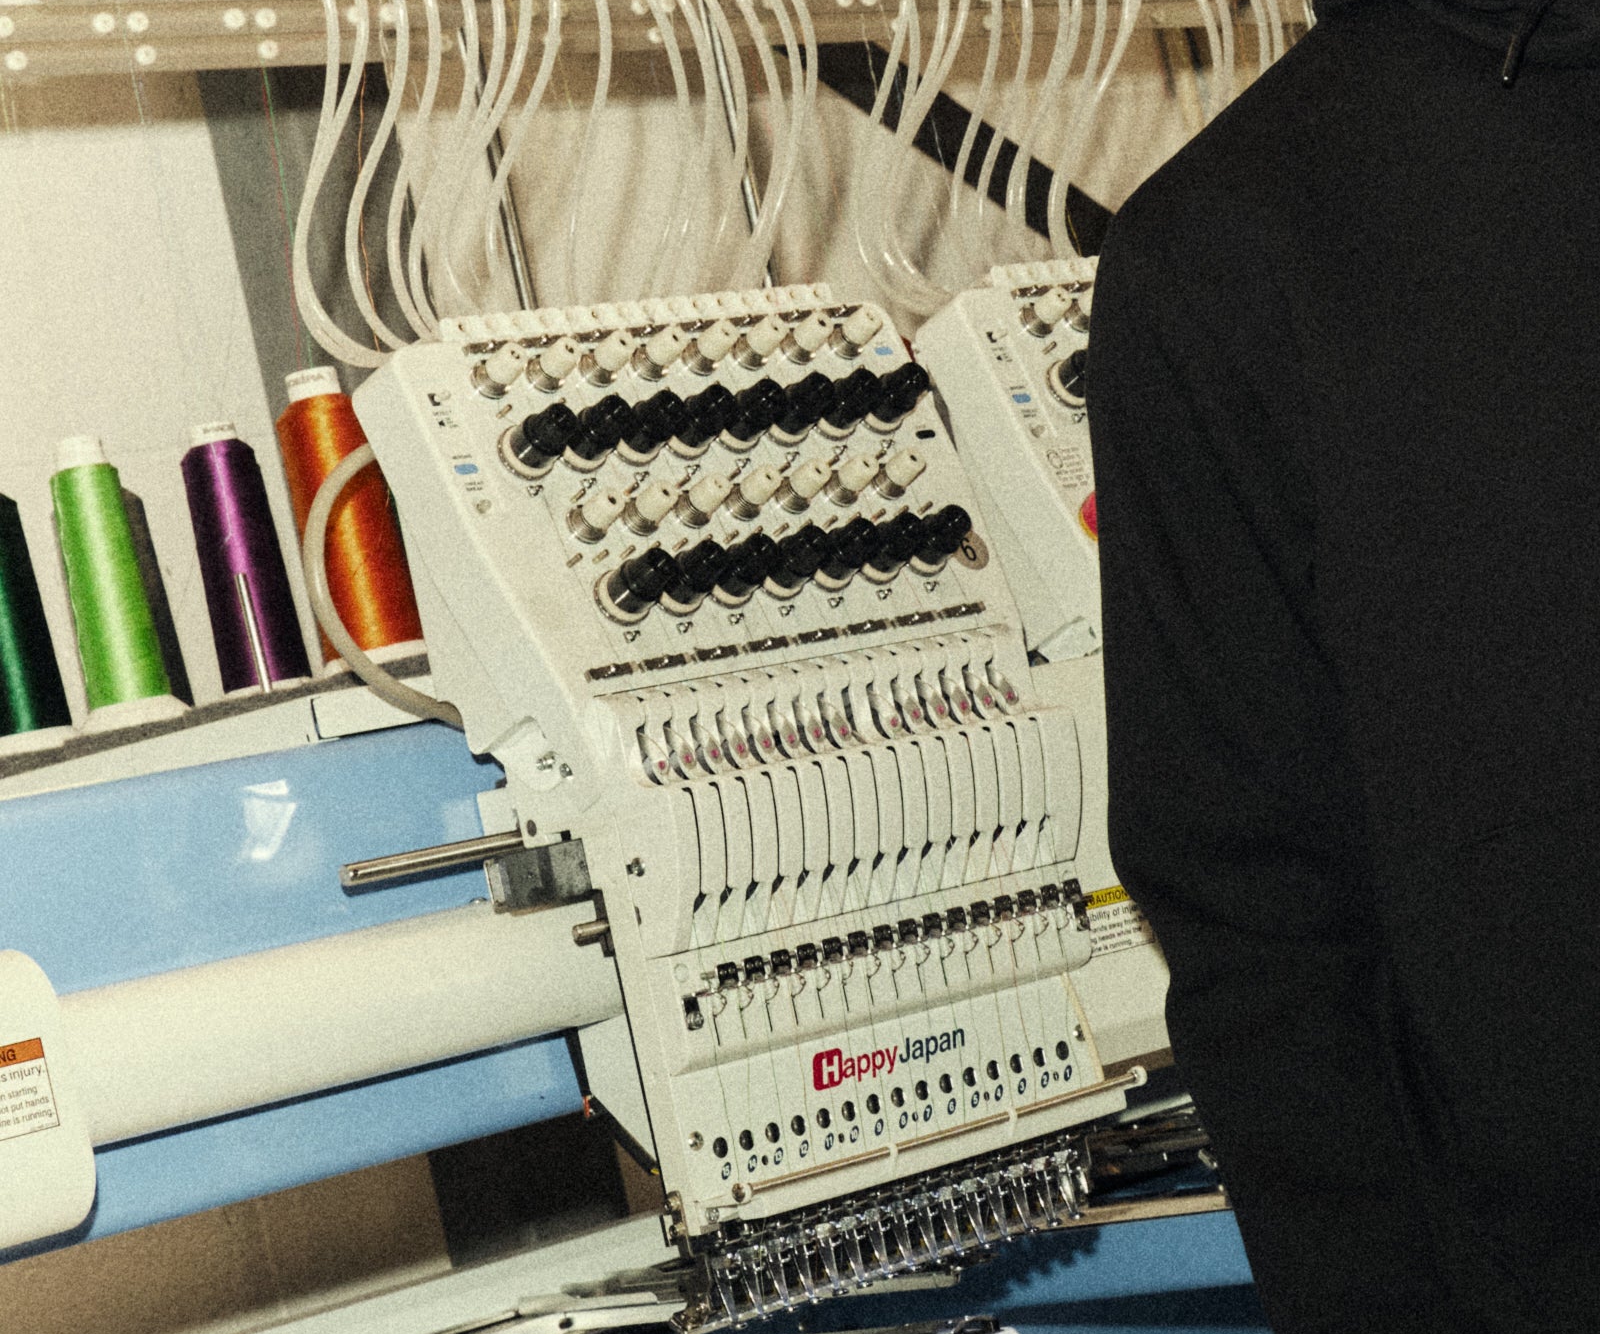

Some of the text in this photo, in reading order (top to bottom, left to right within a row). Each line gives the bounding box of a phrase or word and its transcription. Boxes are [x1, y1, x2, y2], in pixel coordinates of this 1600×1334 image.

[960, 537, 977, 562] 6
[813, 1027, 965, 1091] HappyJapan
[9, 1064, 46, 1081] injury.
[8, 1085, 38, 1099] starting
[11, 1102, 24, 1114] put
[25, 1095, 50, 1108] hands
[13, 1115, 21, 1125] is
